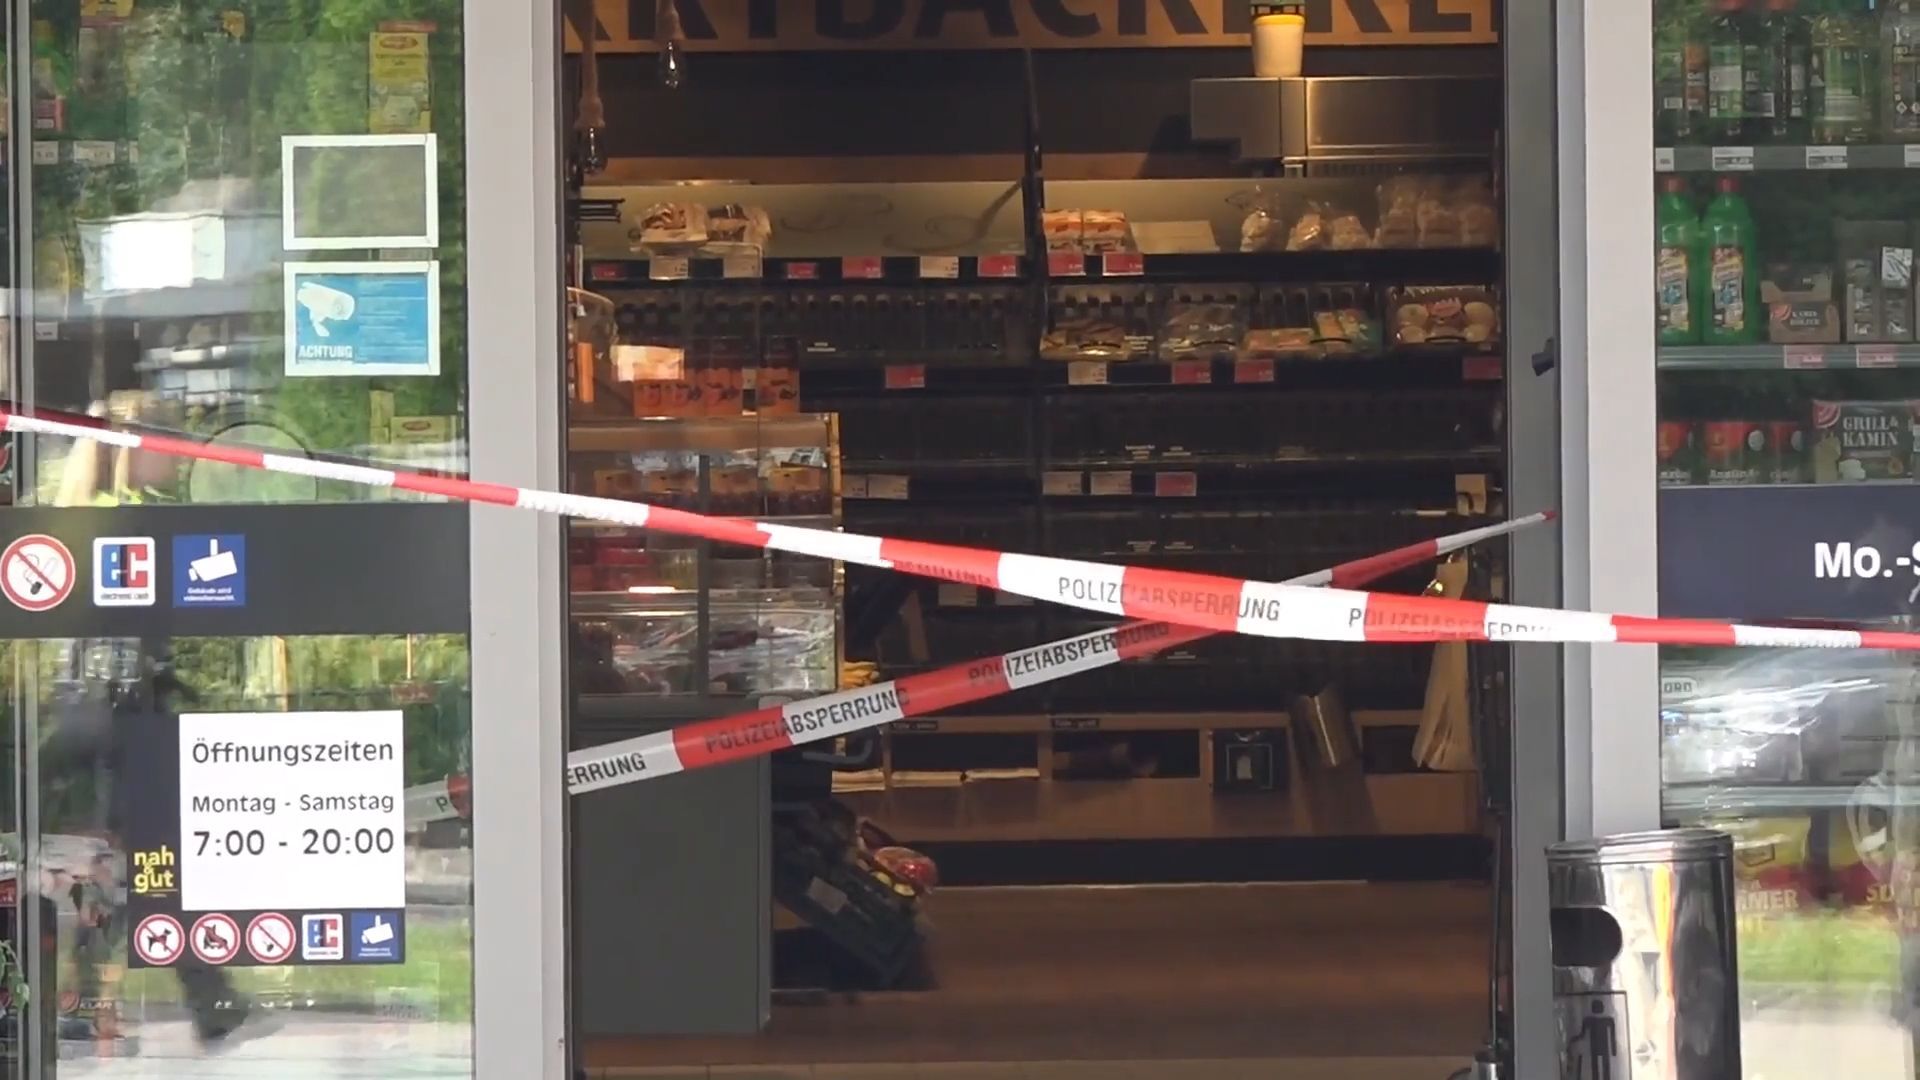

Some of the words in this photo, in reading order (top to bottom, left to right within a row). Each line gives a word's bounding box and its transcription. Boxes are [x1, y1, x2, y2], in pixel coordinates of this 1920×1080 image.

[298, 345, 353, 358] ACHTUNG
[1843, 416, 1889, 430] GRILL
[1843, 431, 1898, 447] KAMIN
[705, 688, 911, 754] POLIZEIABSPERRUNG
[192, 737, 393, 766] Öffnungszeiten
[192, 796, 276, 814] Montag
[300, 794, 394, 813] Samstag
[193, 830, 265, 856] 7:00
[302, 828, 394, 855] 20:00
[134, 845, 174, 867] nah
[134, 869, 175, 893] gut
